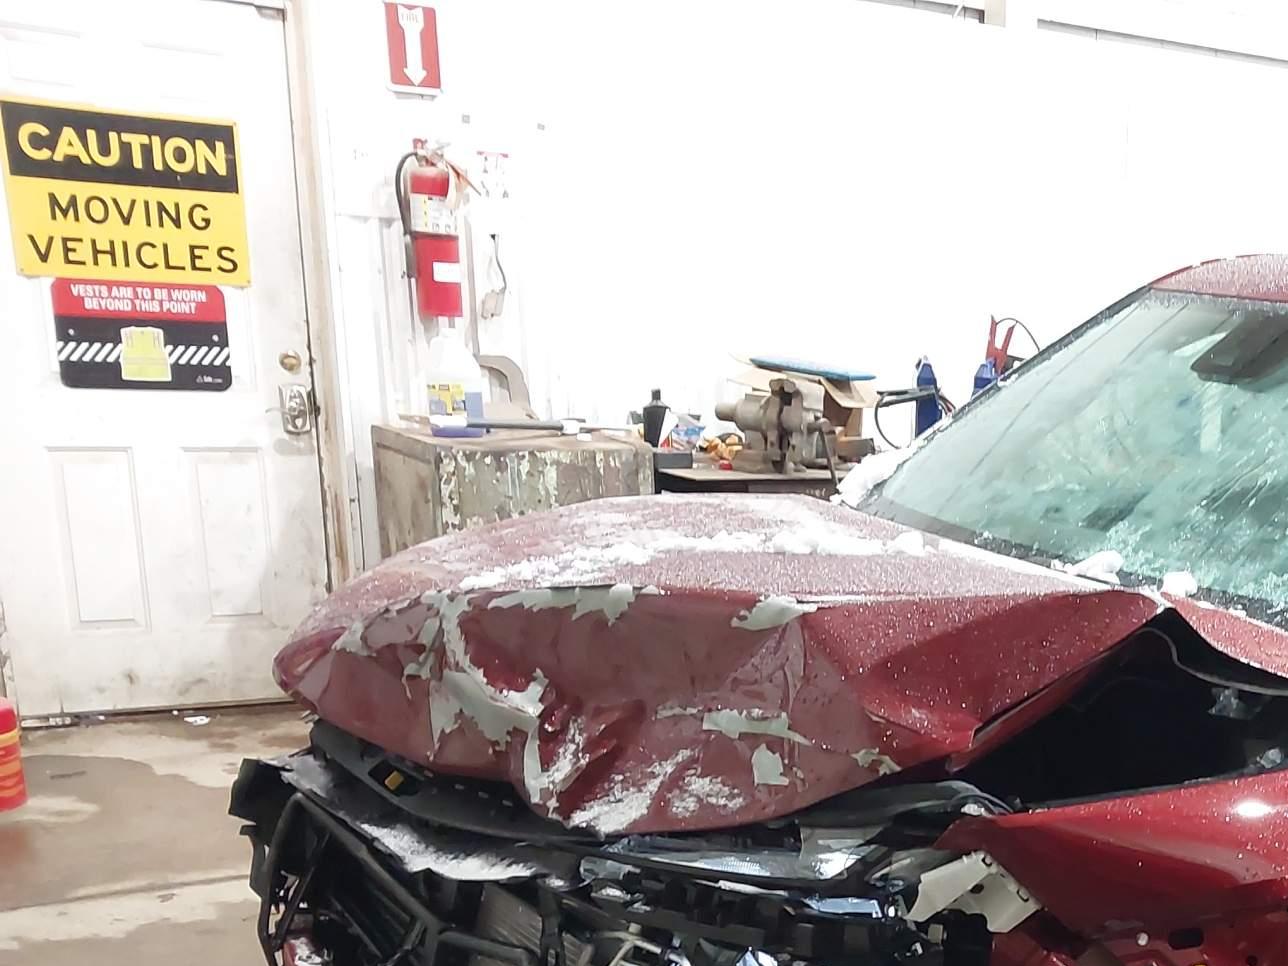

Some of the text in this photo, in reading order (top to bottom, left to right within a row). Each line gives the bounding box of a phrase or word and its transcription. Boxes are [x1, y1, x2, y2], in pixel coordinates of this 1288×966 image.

[17, 121, 227, 177] CAUTION
[47, 192, 211, 231] MOVING
[27, 234, 239, 275] VEHICLES
[70, 284, 206, 303] VESTS ARE TO BE WORN
[84, 297, 196, 314] BEYOND THIS POINT
